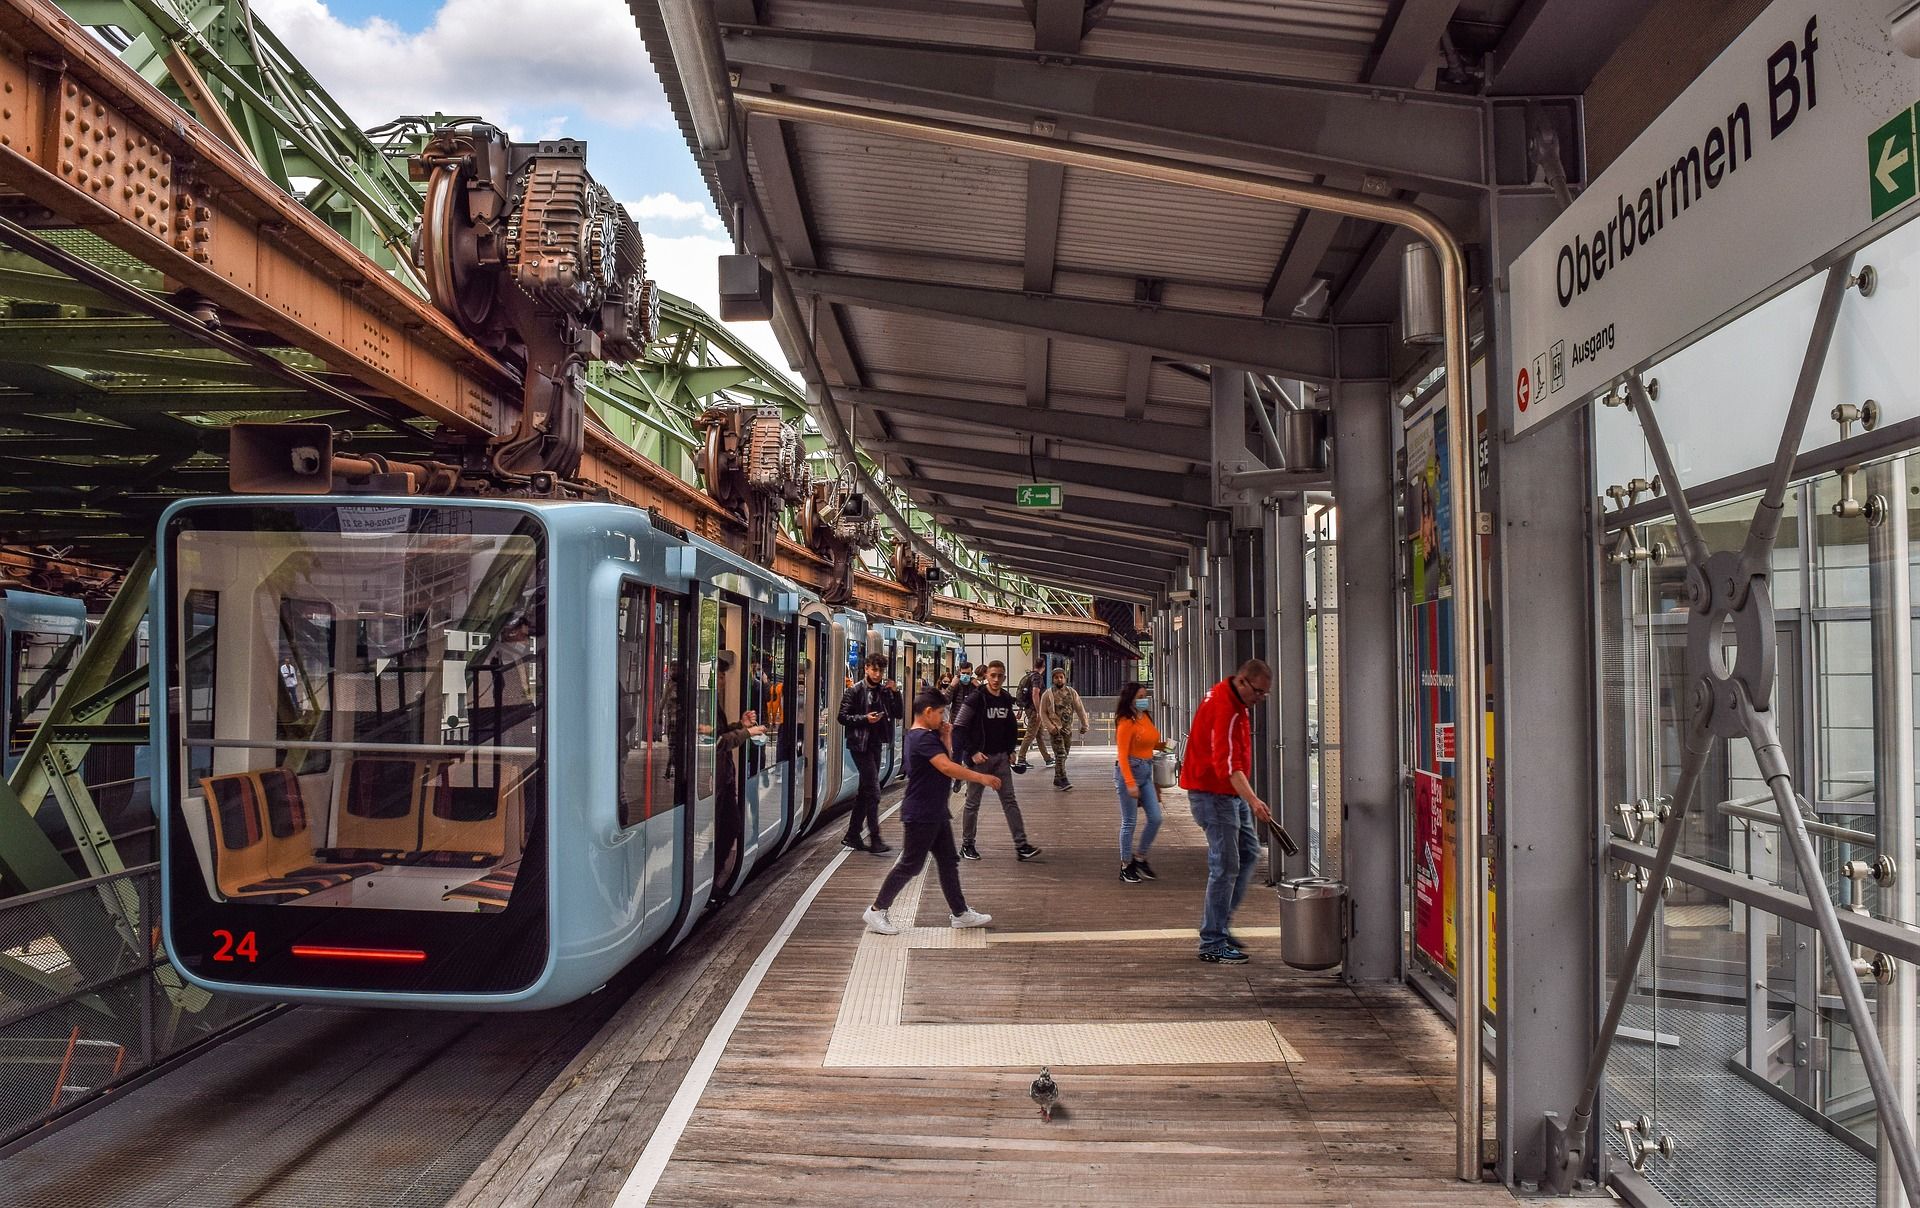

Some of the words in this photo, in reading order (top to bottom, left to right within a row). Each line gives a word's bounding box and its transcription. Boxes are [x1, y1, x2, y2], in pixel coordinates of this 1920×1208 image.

[1556, 102, 1752, 308] Oberbarmen
[1767, 15, 1819, 141] Bf
[1572, 323, 1615, 368] Ausgang
[1023, 637, 1030, 645] A
[212, 929, 259, 963] 24
